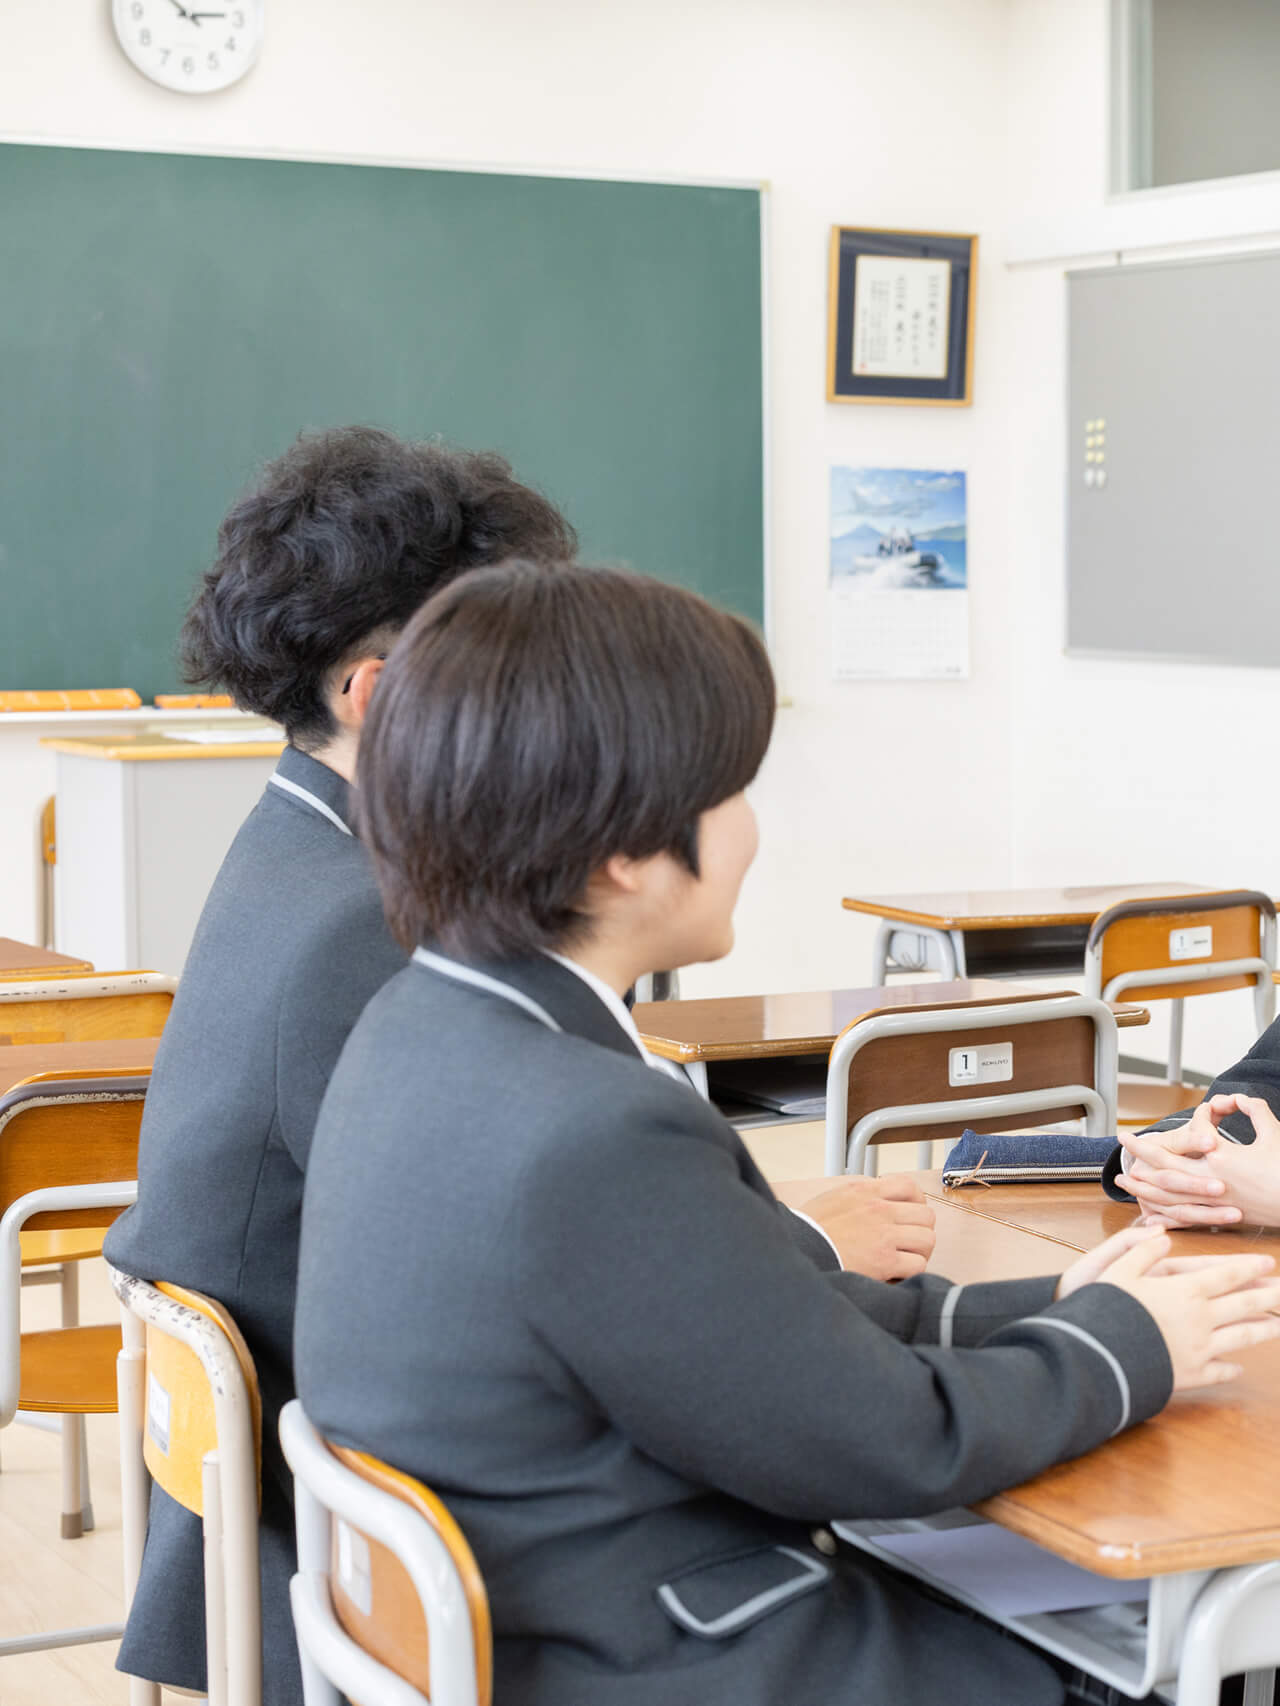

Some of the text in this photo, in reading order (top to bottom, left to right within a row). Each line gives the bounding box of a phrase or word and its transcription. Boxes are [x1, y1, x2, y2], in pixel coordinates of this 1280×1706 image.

[131, 2, 144, 20] 9
[232, 10, 245, 29] 3
[139, 28, 152, 46] 8
[225, 36, 237, 51] 4
[160, 48, 171, 66] 7
[182, 56, 195, 75] 6
[207, 51, 219, 70] 5
[961, 1054, 968, 1070] 1
